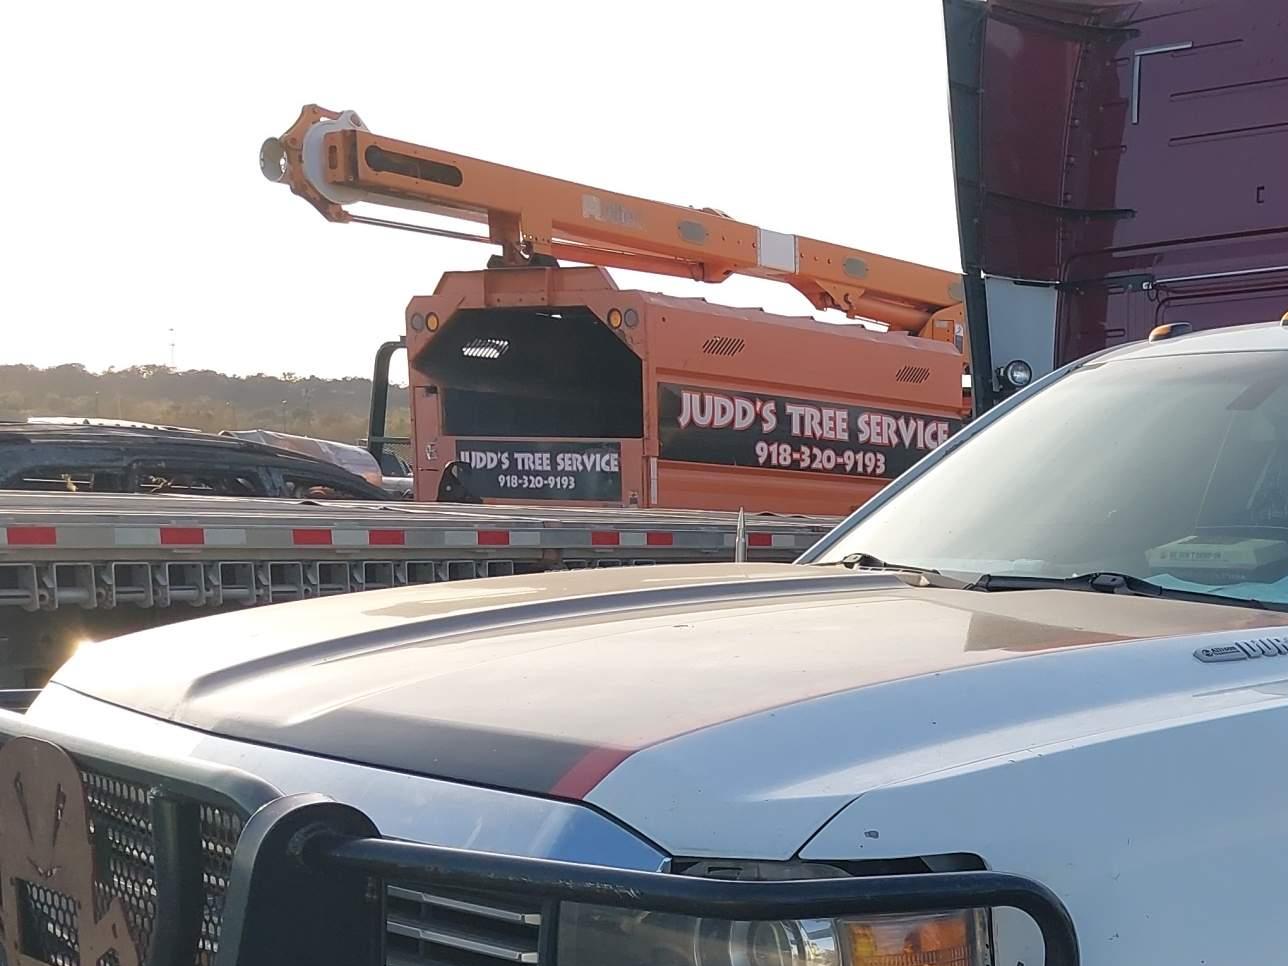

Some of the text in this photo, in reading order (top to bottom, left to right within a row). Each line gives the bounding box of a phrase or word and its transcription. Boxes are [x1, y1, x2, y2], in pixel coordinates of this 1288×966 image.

[679, 390, 950, 449] JUDD'S TREE SERVICE
[514, 452, 550, 471] TREE
[556, 453, 619, 472] SERVICE
[755, 440, 886, 475] 918-320-9193
[498, 474, 575, 489] 918-320-9193
